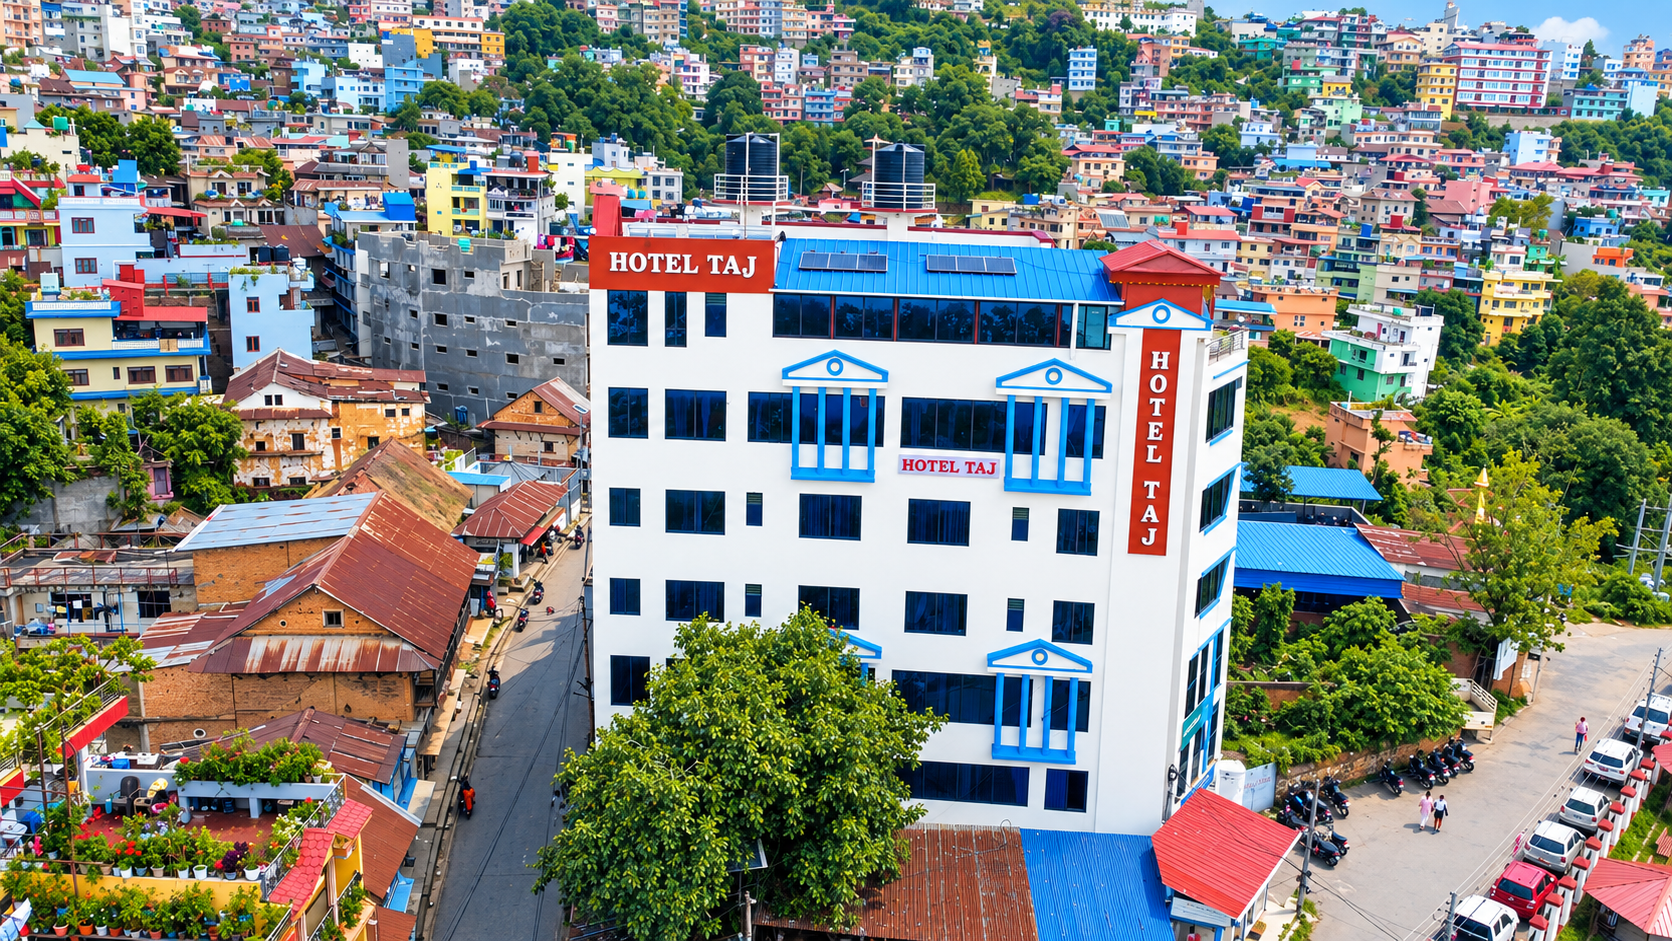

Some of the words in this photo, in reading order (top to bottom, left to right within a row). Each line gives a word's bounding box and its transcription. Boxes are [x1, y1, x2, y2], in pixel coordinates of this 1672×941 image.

[609, 252, 699, 274] HOTEL
[707, 255, 757, 278] TAJ
[1145, 351, 1170, 463] HOTEL
[901, 458, 960, 473] HOTEL
[964, 461, 997, 475] TAJ
[1140, 481, 1160, 546] TAJ
